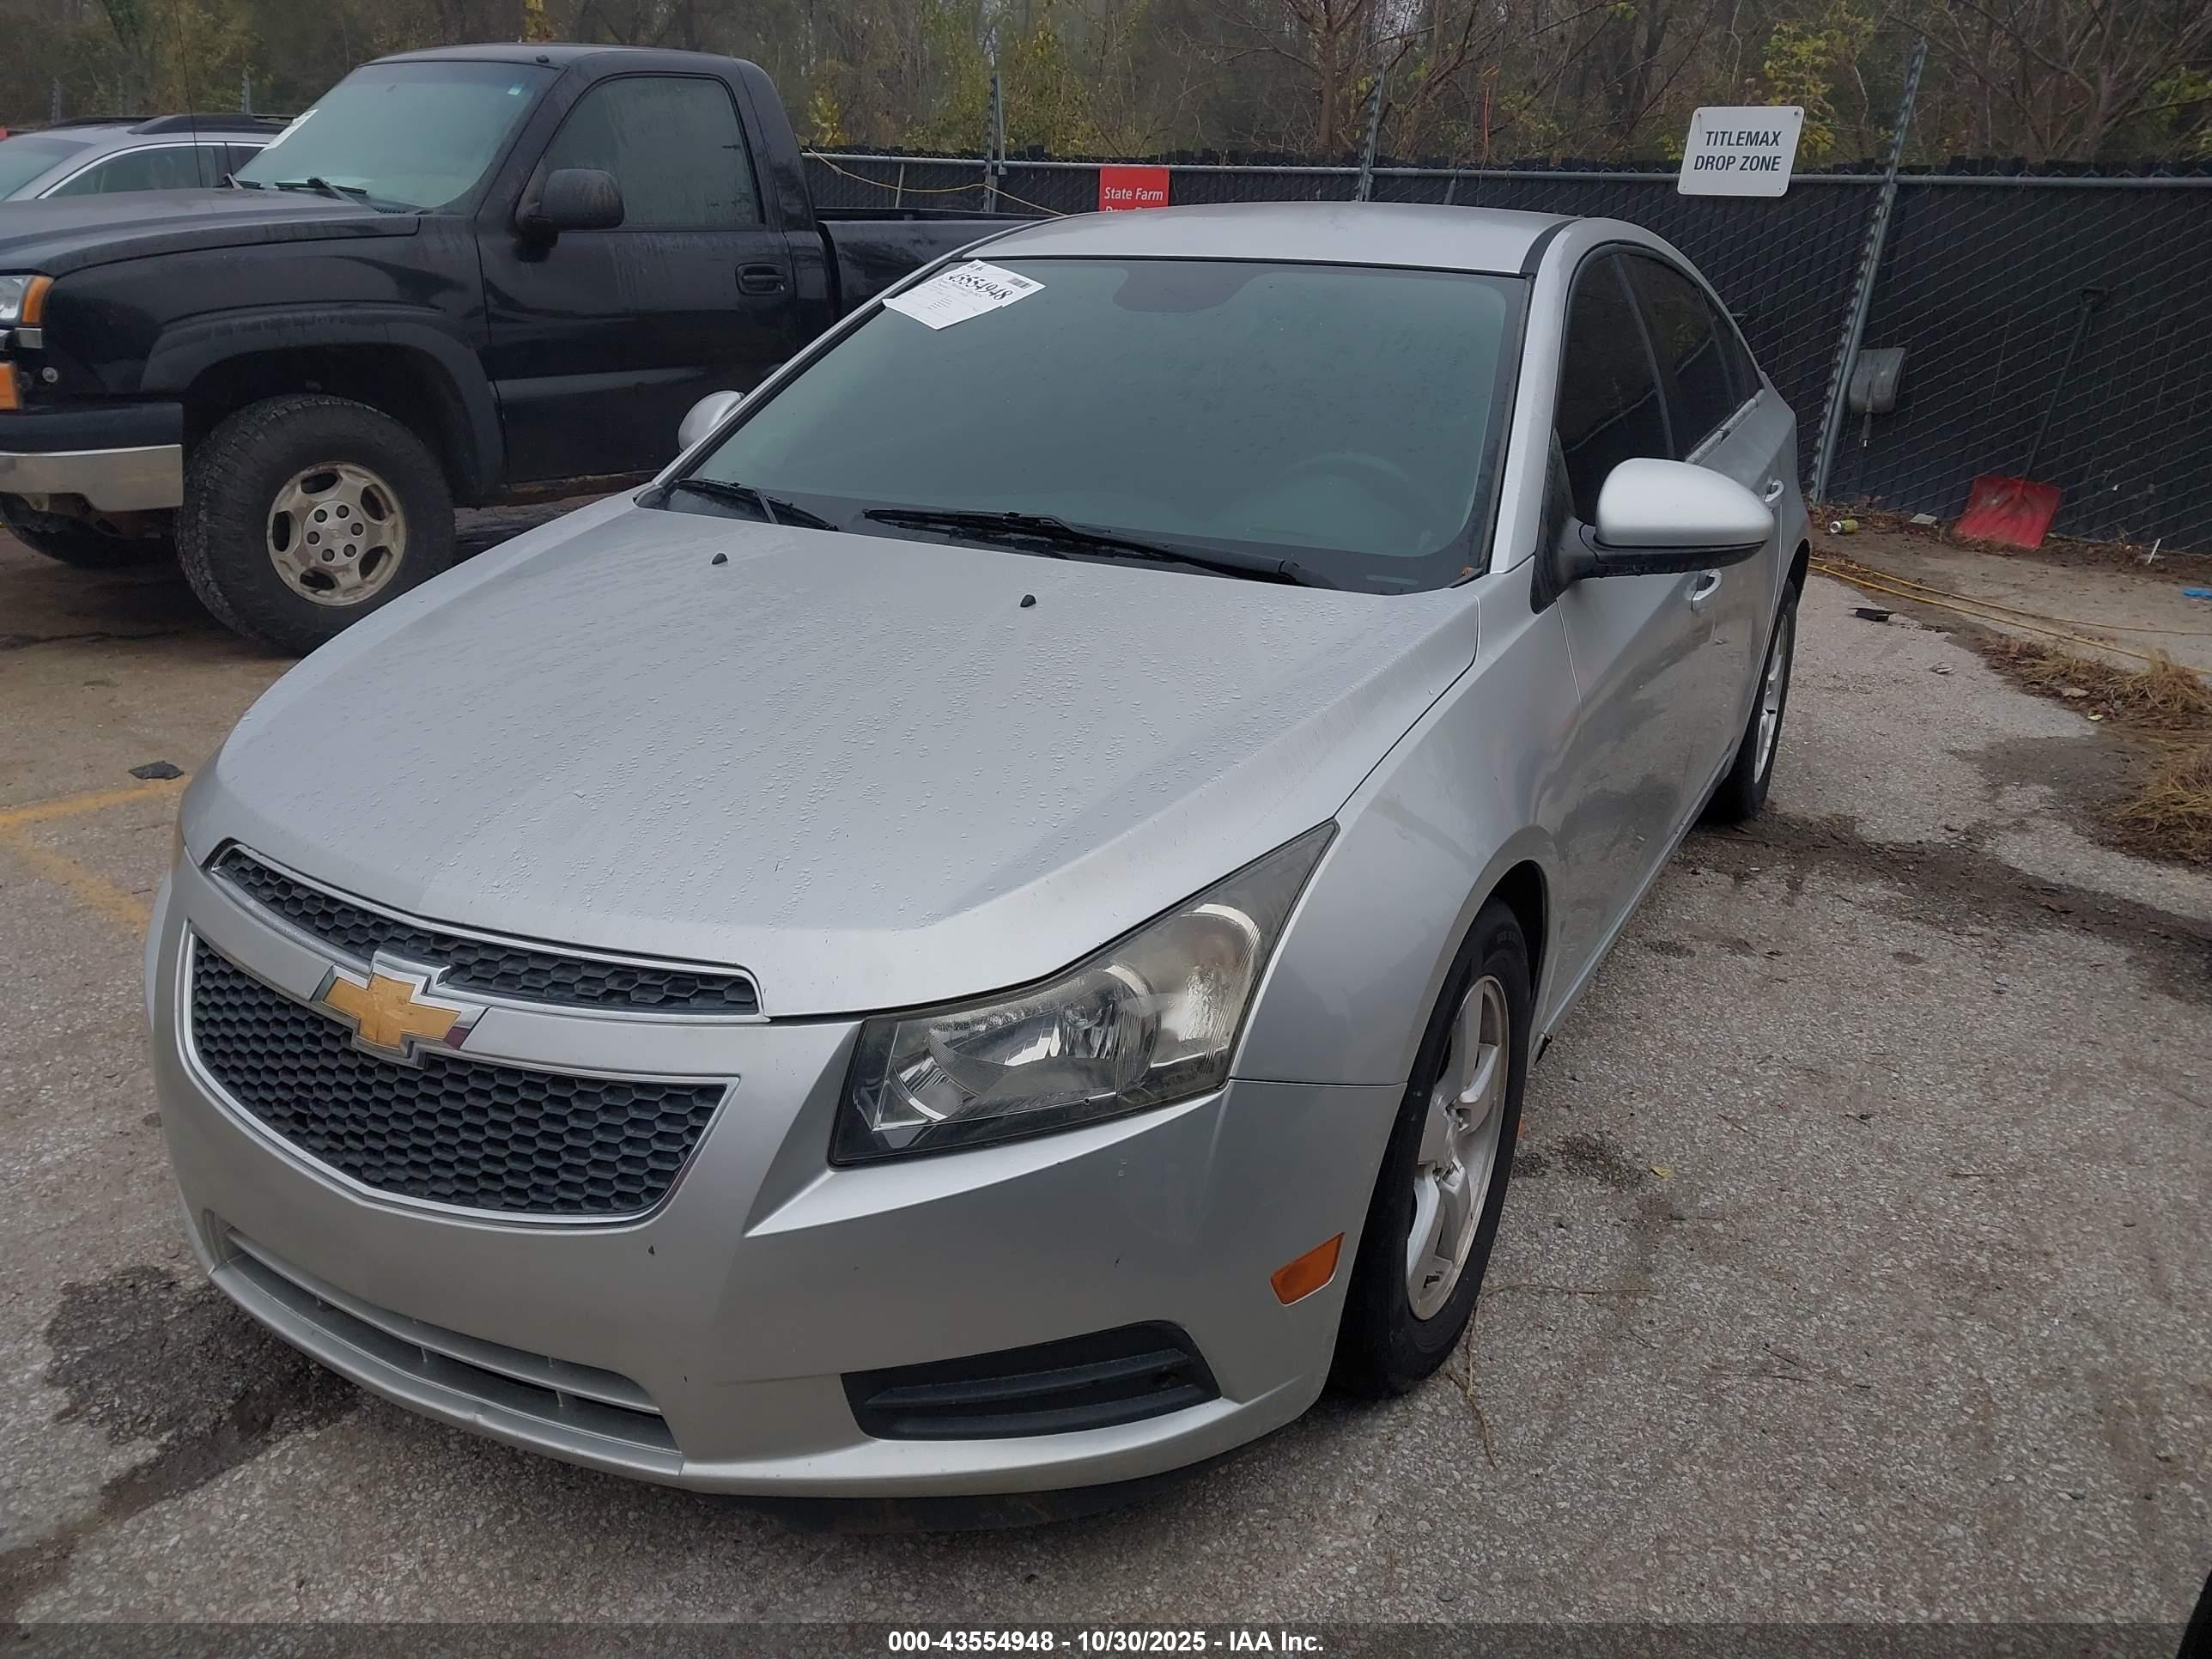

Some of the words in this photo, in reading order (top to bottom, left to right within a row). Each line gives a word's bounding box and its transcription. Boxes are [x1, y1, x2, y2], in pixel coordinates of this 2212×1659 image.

[1705, 131, 1782, 146] TITLEMAX
[1693, 155, 1736, 171] DROP
[1739, 155, 1782, 171] ZONE
[1104, 186, 1133, 200] State
[1135, 187, 1164, 201] Farm
